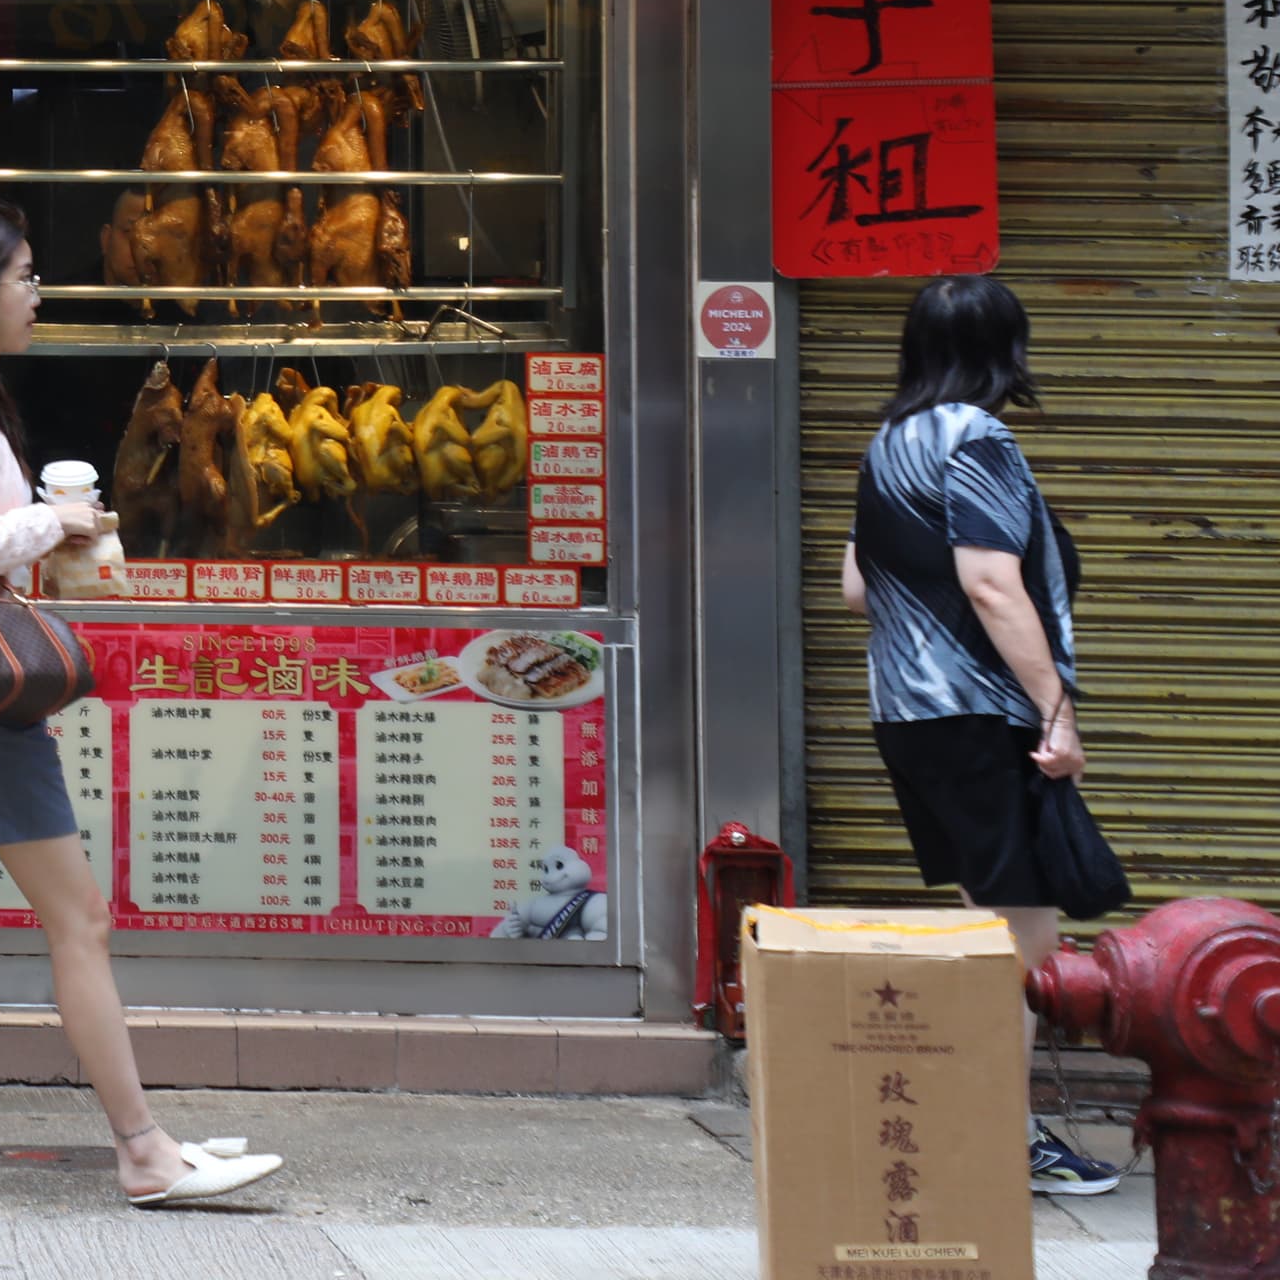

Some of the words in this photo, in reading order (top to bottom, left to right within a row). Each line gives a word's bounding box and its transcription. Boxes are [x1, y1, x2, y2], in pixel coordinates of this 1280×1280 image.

[708, 309, 764, 319] MICHELIN
[722, 322, 752, 332] 2024
[532, 361, 599, 375] 滷豆腐
[533, 403, 600, 417] 滷水蛋
[129, 655, 371, 698] 生記滷味
[262, 710, 287, 720] 60元
[263, 731, 287, 741] 15元
[492, 755, 517, 766] 30元
[263, 813, 287, 823] 30元
[490, 818, 519, 828] 138元
[260, 834, 290, 844] 300元
[261, 896, 290, 906] 100元
[878, 1071, 920, 1244] 玫瑰露酒
[847, 1248, 868, 1258] MEI
[905, 1248, 921, 1258] LU
[924, 1247, 967, 1258] CHIEW
